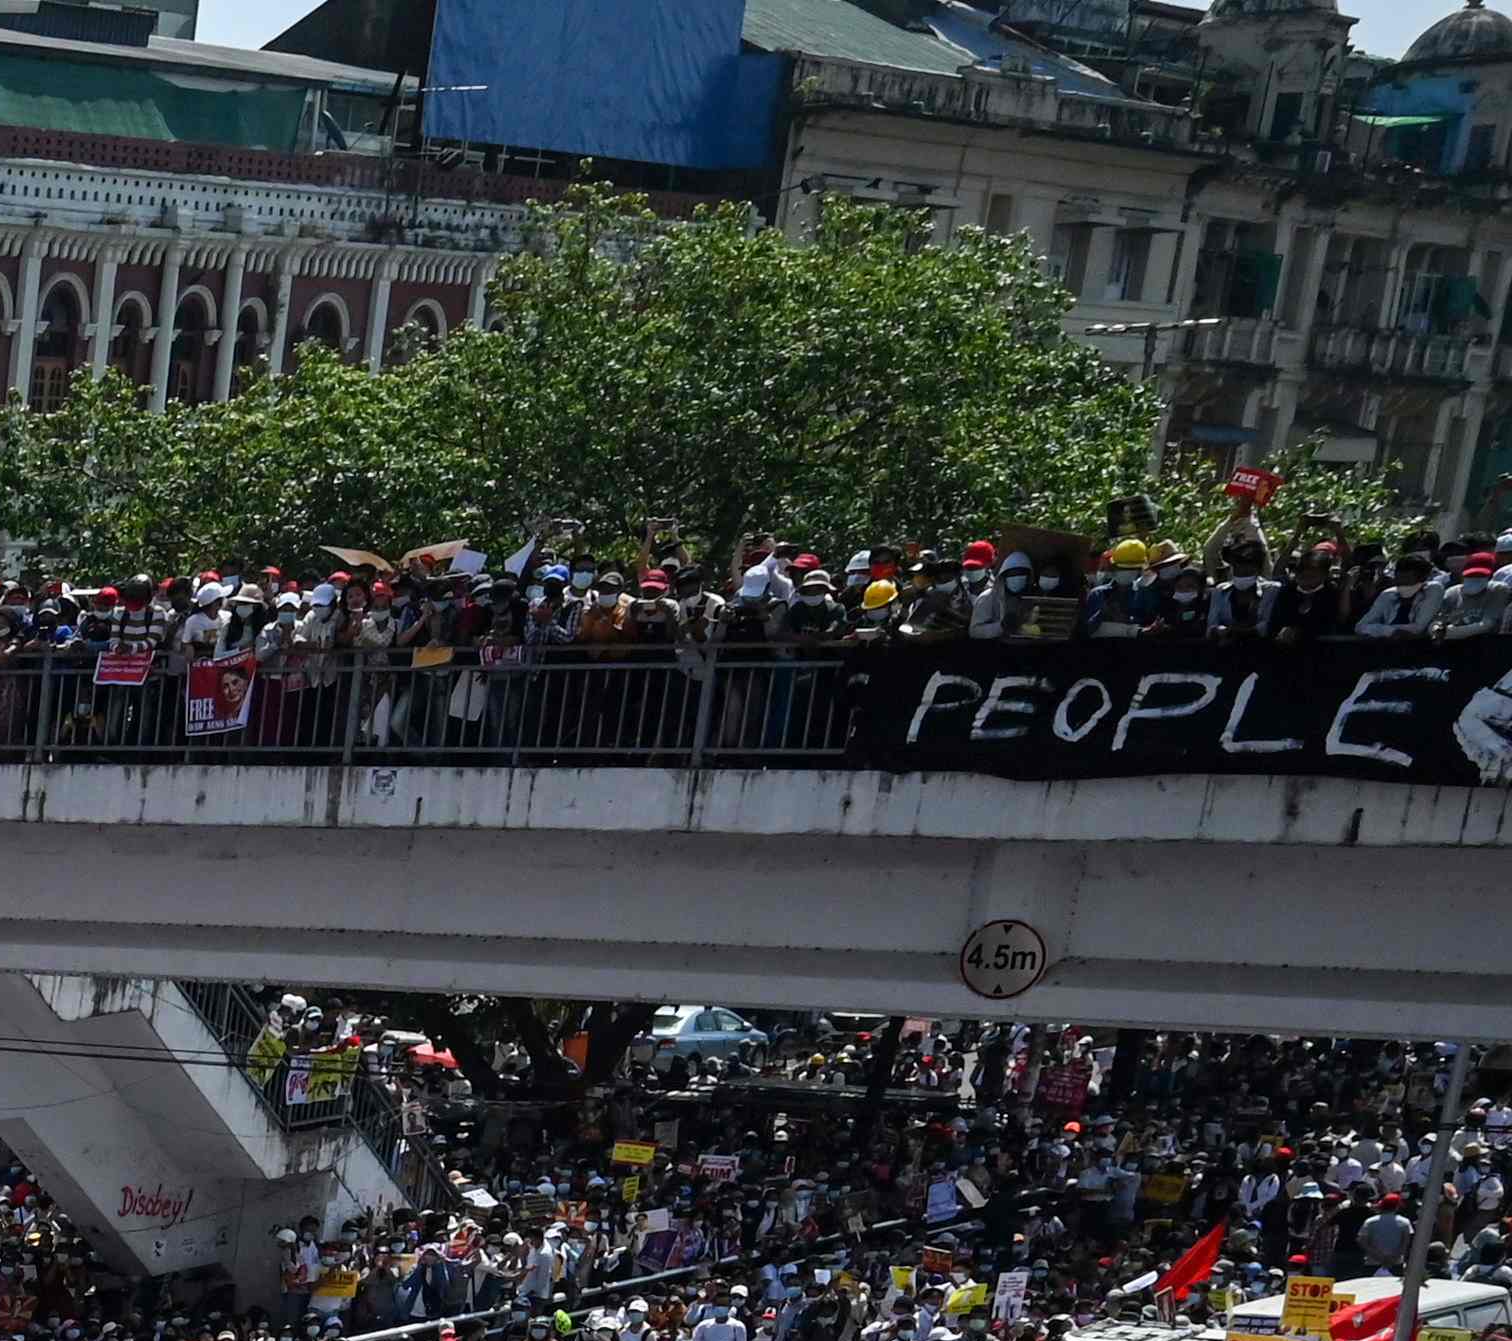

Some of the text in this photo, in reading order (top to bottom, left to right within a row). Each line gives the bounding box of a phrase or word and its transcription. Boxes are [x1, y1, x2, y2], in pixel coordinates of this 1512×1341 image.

[1233, 471, 1260, 486] FREE
[189, 698, 215, 721] FREE
[906, 668, 1451, 768] PEOPLE
[966, 943, 1037, 972] 4.5m
[117, 1181, 194, 1231] Disobey!
[1289, 1282, 1331, 1298] STOP
